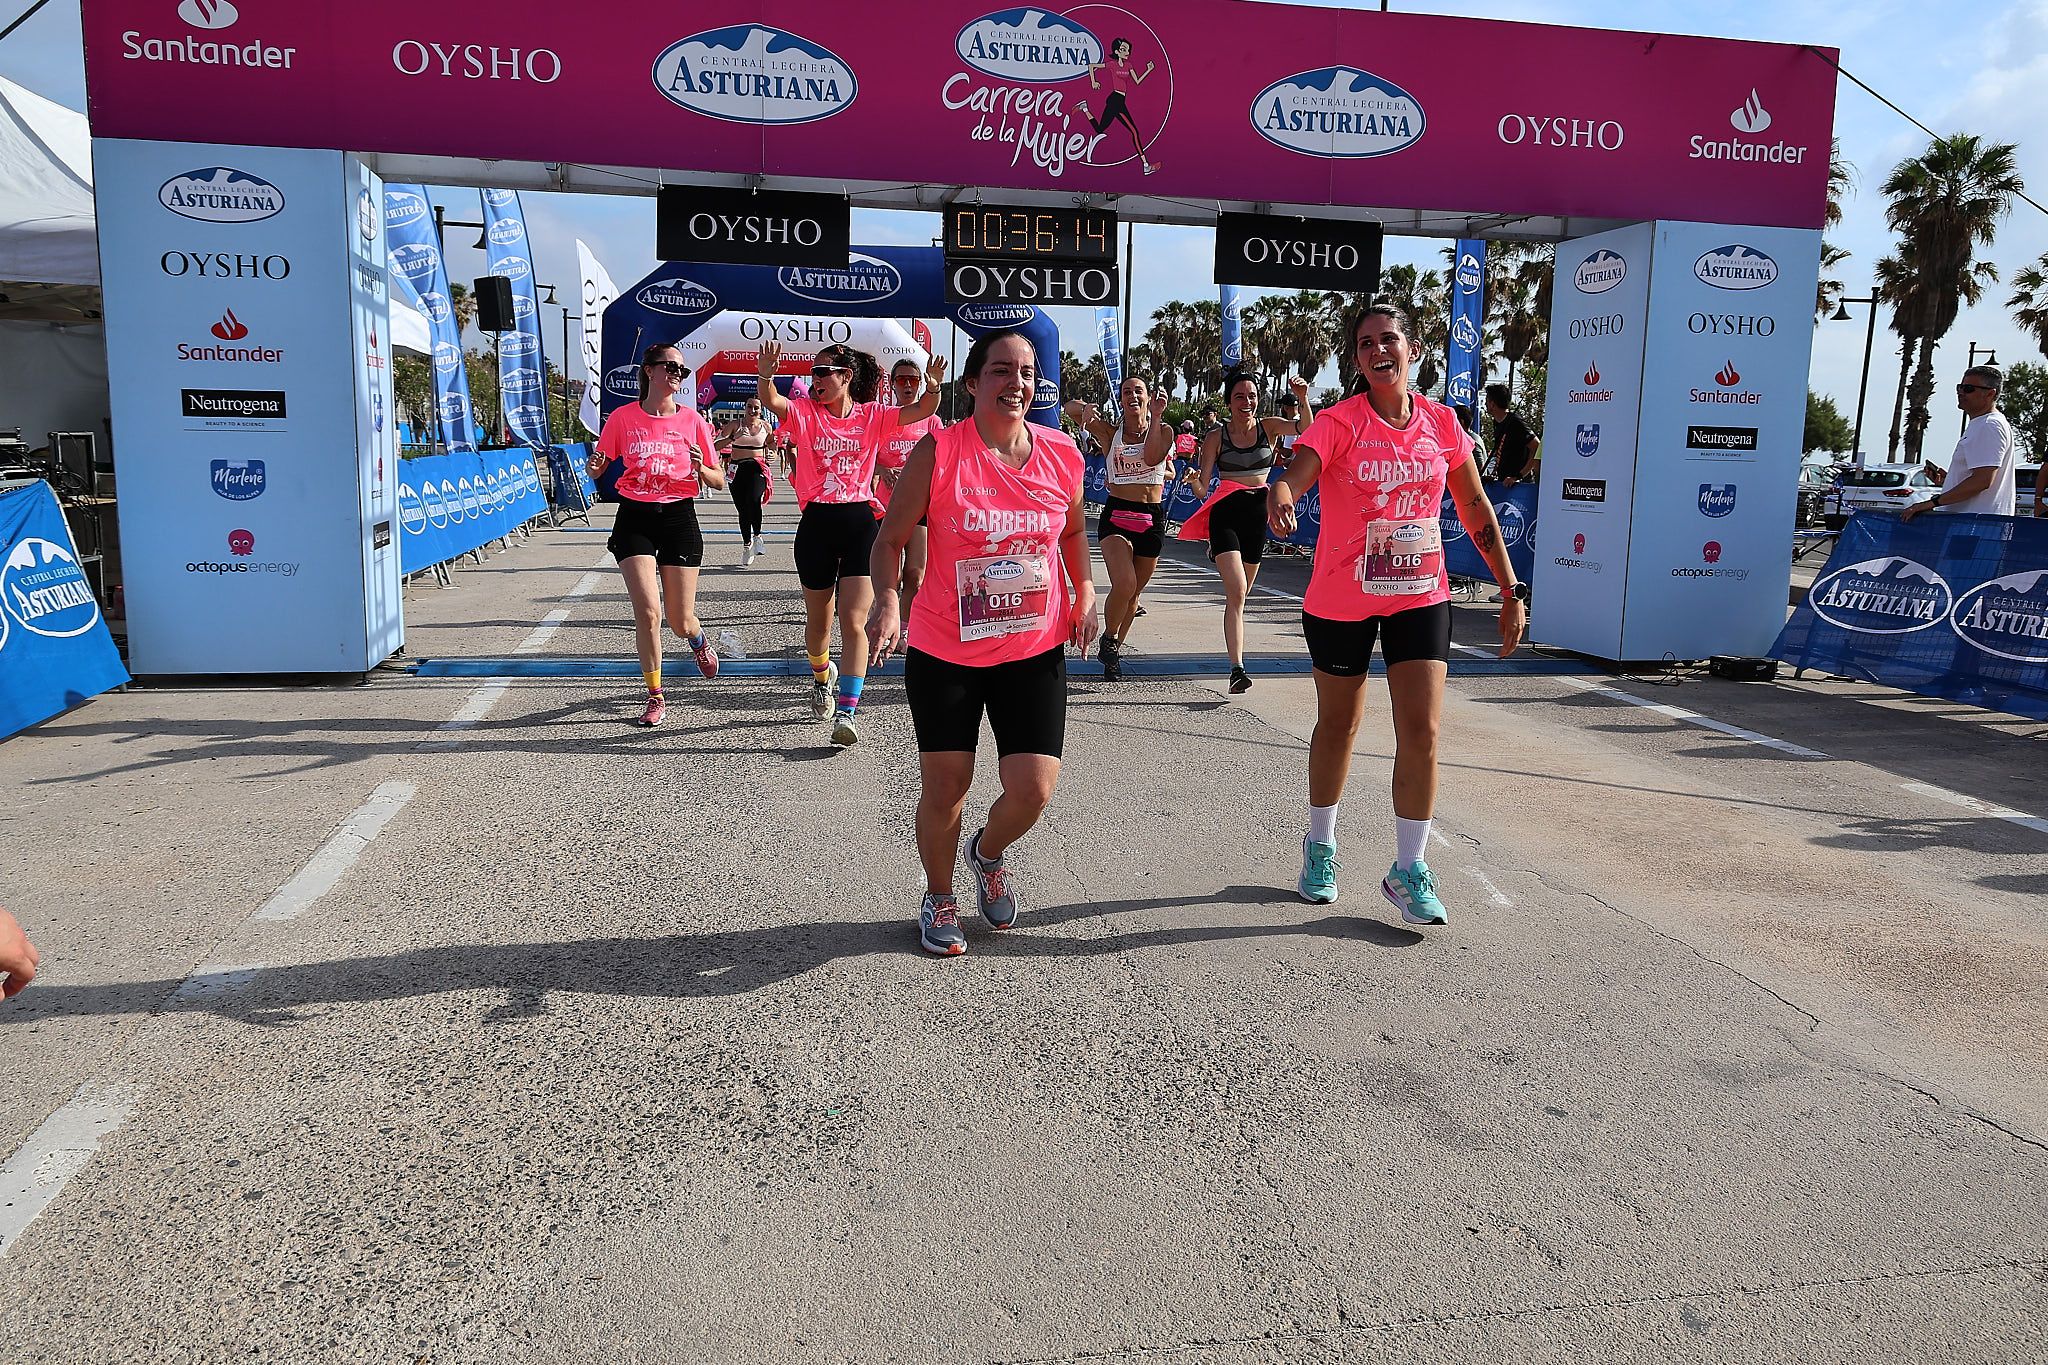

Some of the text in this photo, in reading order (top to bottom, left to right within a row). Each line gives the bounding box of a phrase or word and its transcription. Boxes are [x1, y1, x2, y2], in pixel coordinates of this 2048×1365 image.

[990, 30, 1088, 44] CENTRAL LECHERA
[122, 30, 296, 69] Santander
[967, 31, 1090, 65] ASTURIANA
[392, 40, 562, 83] OYSHO
[701, 56, 835, 73] CENTRAL LECHERA
[669, 56, 842, 102] ASTURIANA
[942, 73, 1063, 117] Carrera
[1293, 96, 1407, 111] CENTRAL LECHERA
[1264, 97, 1412, 137] ASTURIANA
[1497, 114, 1625, 150] OYSHO
[971, 114, 1107, 177] de la Mujer
[1689, 135, 1807, 164] Santander
[168, 186, 276, 210] ASTURIANA
[689, 213, 822, 246] OYSHO
[957, 211, 1105, 252] 00:36:14
[1243, 237, 1359, 270] OYSHO
[160, 250, 290, 280] OYSHO
[1699, 259, 1771, 280] ASTURIANA
[787, 267, 892, 291] ASTURIANA
[953, 265, 1111, 301] OYSHO
[1577, 267, 1622, 286] ASTURIANA
[642, 289, 710, 308] ASTURIANA
[964, 307, 1030, 320] ASTURIANA
[740, 317, 852, 343] OYSHO
[1569, 313, 1624, 339] OYSHO
[1688, 312, 1775, 337] OYSHO
[177, 343, 283, 362] Santander
[724, 350, 754, 362] Sports
[779, 353, 817, 361] antande
[608, 375, 641, 389] ASTUR
[189, 394, 280, 414] Neutrogena
[1569, 388, 1613, 403] Santander
[1689, 388, 1762, 404] Santander
[814, 437, 860, 452] CARRERA
[890, 440, 918, 451] CARRE
[1357, 440, 1390, 449] OYSHO
[1692, 431, 1753, 447] Neutrogena
[629, 442, 675, 456] CARRERA
[214, 468, 263, 490] Marlene
[1358, 461, 1433, 482] CARRERA
[961, 486, 998, 497] OYSHO
[1565, 483, 1603, 499] Neutrogena
[1701, 491, 1734, 509] Marlene
[963, 509, 1051, 532] CARRERA
[1392, 554, 1421, 567] 016
[20, 571, 54, 586] CENTRAL
[988, 568, 1022, 577] ASTURIANA
[1848, 579, 1939, 597] CENTRAL LECHERA
[989, 593, 1023, 609] 016
[1818, 578, 1936, 621] ASTURIANA
[1993, 596, 2040, 610] CENTRAL
[971, 625, 997, 635] OYSHO
